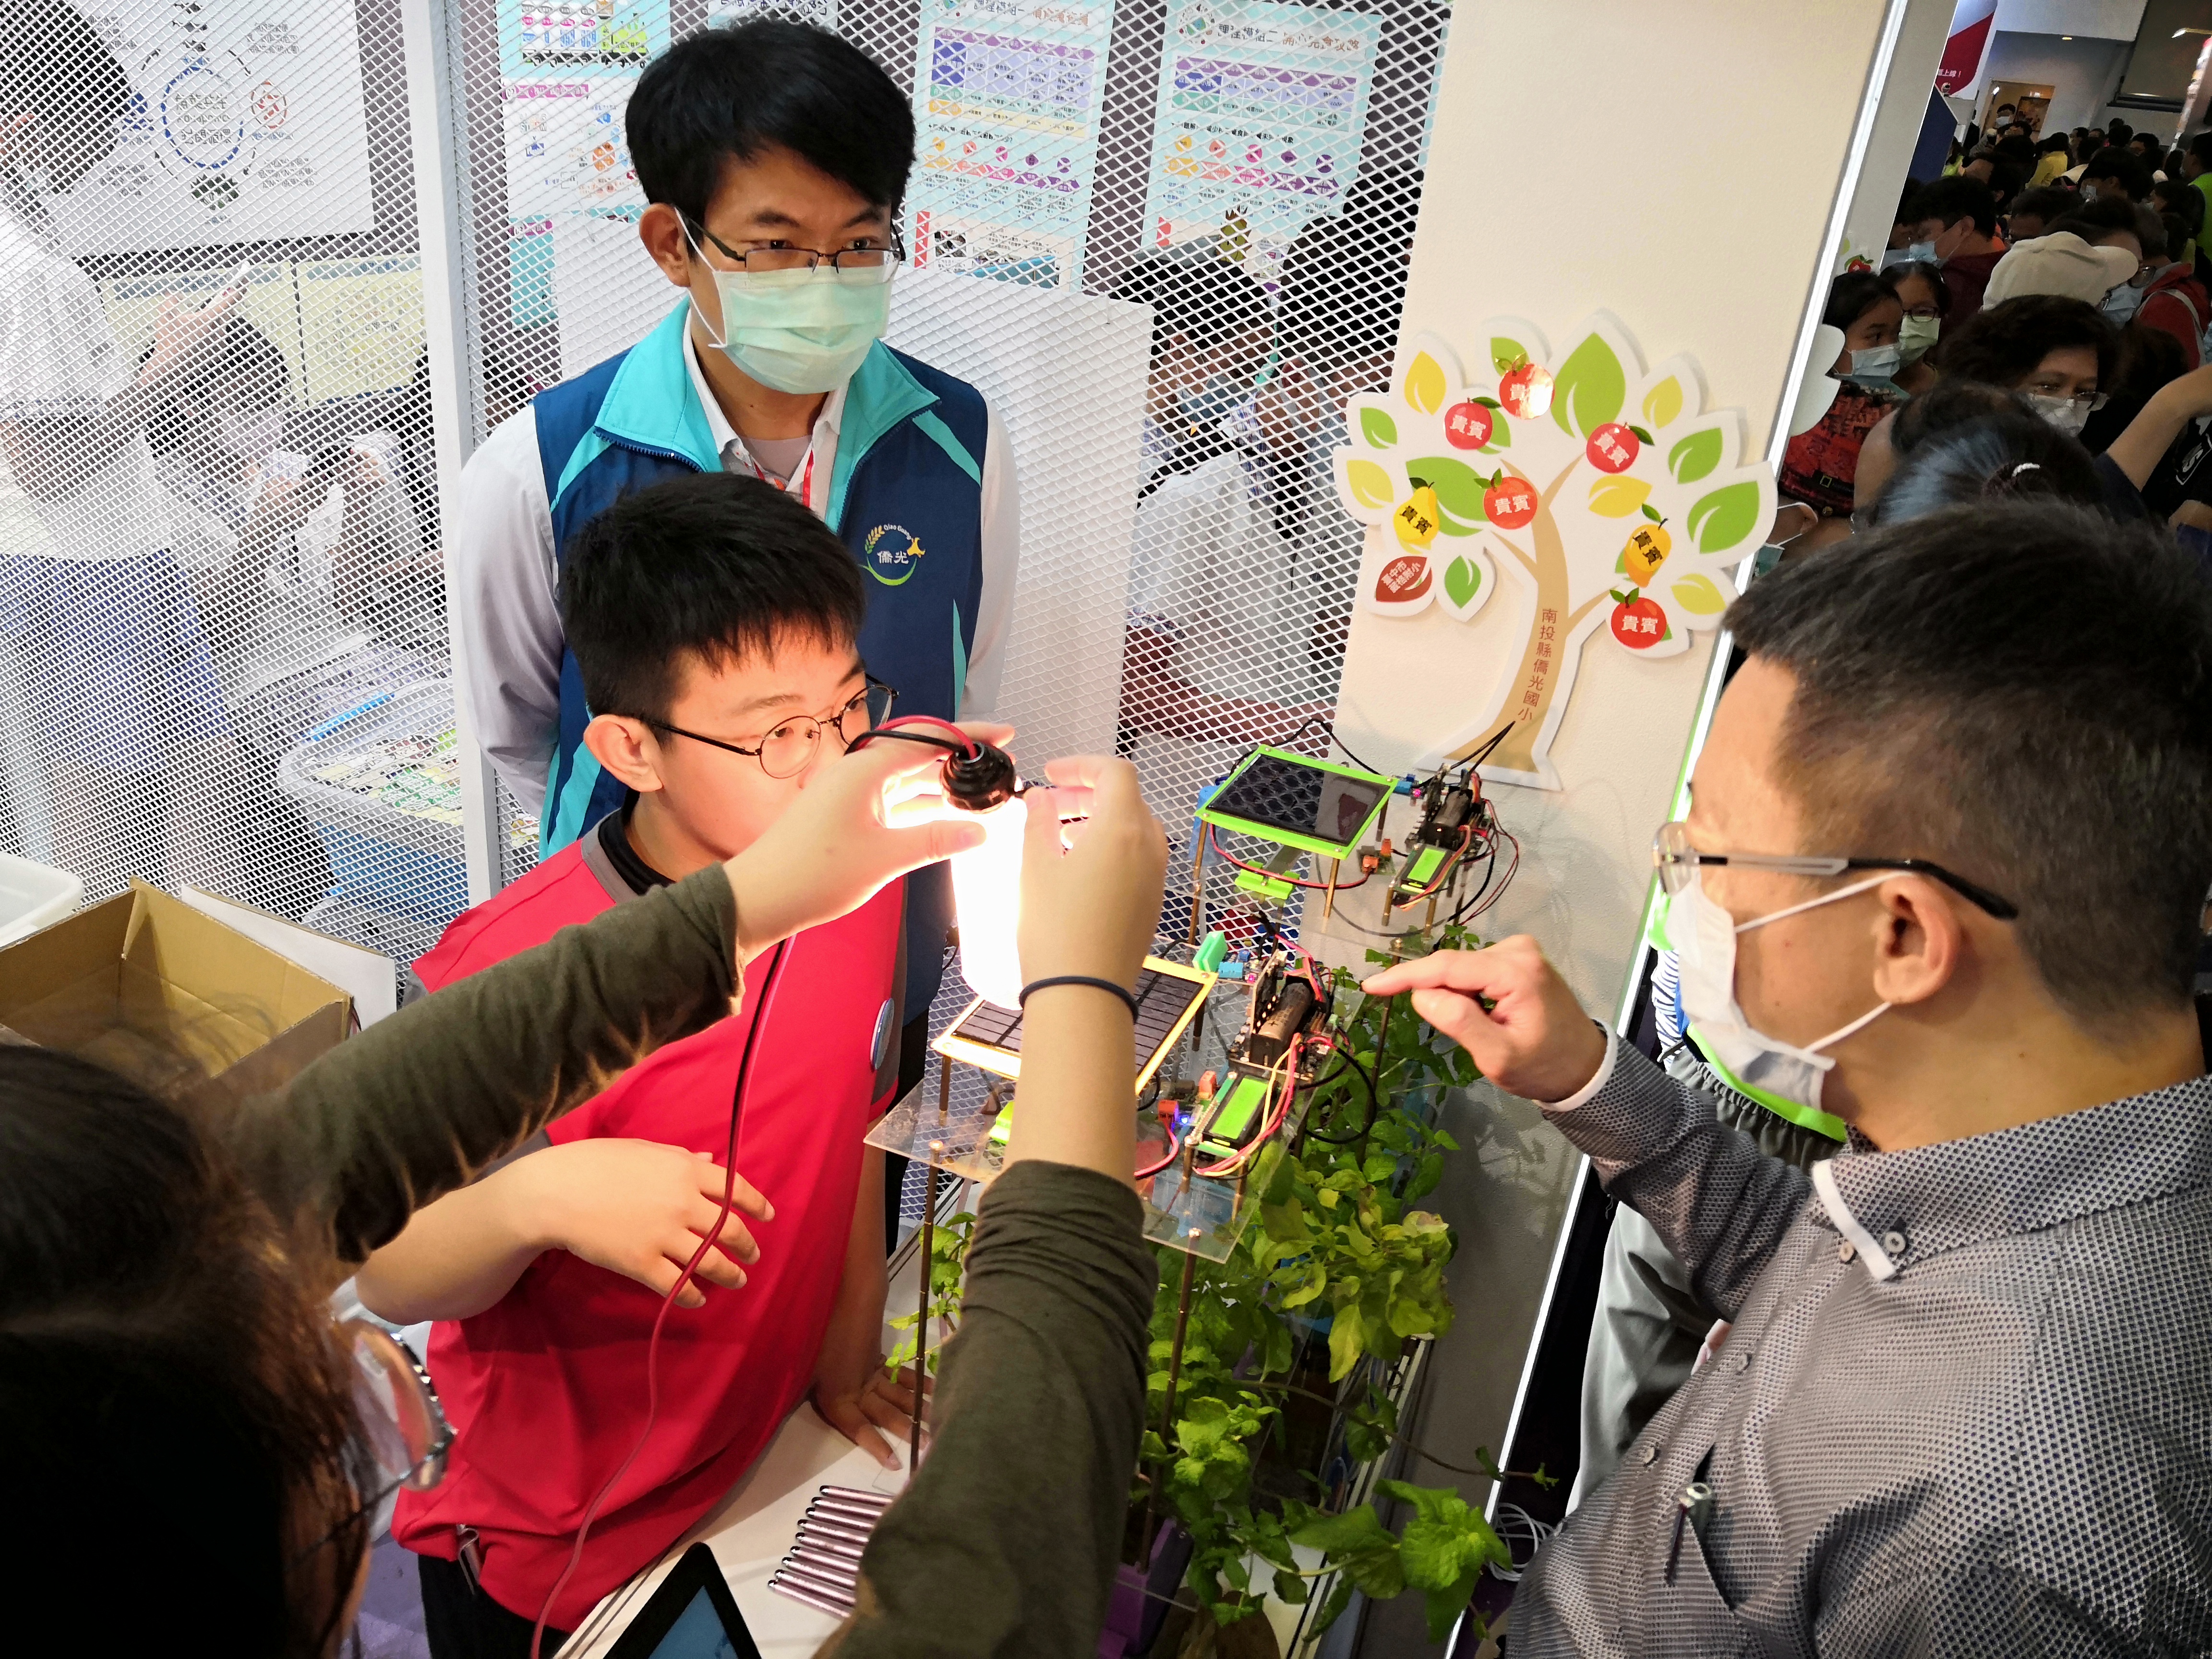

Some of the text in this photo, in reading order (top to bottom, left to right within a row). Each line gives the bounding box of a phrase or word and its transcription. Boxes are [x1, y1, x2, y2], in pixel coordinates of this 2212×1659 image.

[1449, 414, 1487, 440] 貴賓
[1593, 433, 1630, 468] 貴賓
[1494, 495, 1530, 516] 貴賓
[1399, 505, 1432, 536] 貴賓
[877, 551, 909, 564] 僑光
[1633, 531, 1663, 566] 貴賓
[1622, 615, 1658, 635] 貴賓
[1518, 608, 1558, 721] 南投縣僑光國小
